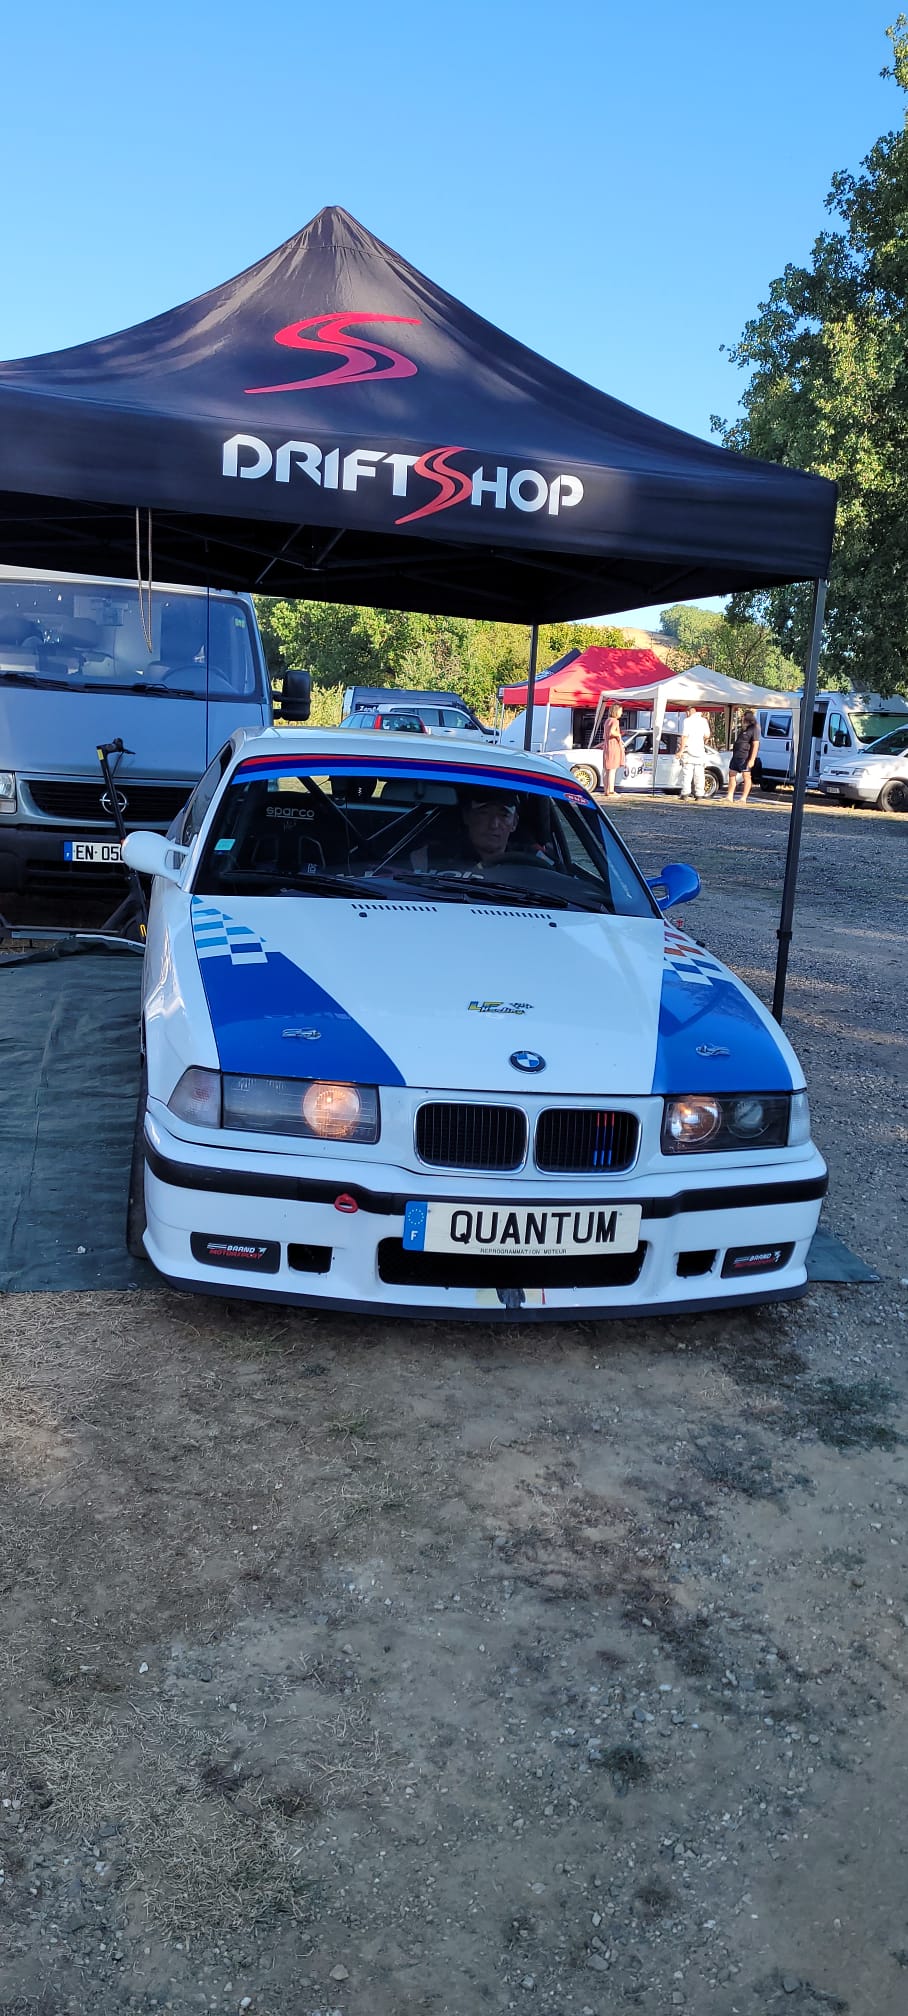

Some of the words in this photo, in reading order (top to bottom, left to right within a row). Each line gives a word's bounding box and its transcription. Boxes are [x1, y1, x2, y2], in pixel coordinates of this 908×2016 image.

[222, 433, 585, 524] DRIFTSHOP
[265, 806, 315, 818] sparco
[449, 1210, 618, 1245] QUANTUM
[410, 1230, 418, 1241] F
[227, 1245, 256, 1254] BRAND
